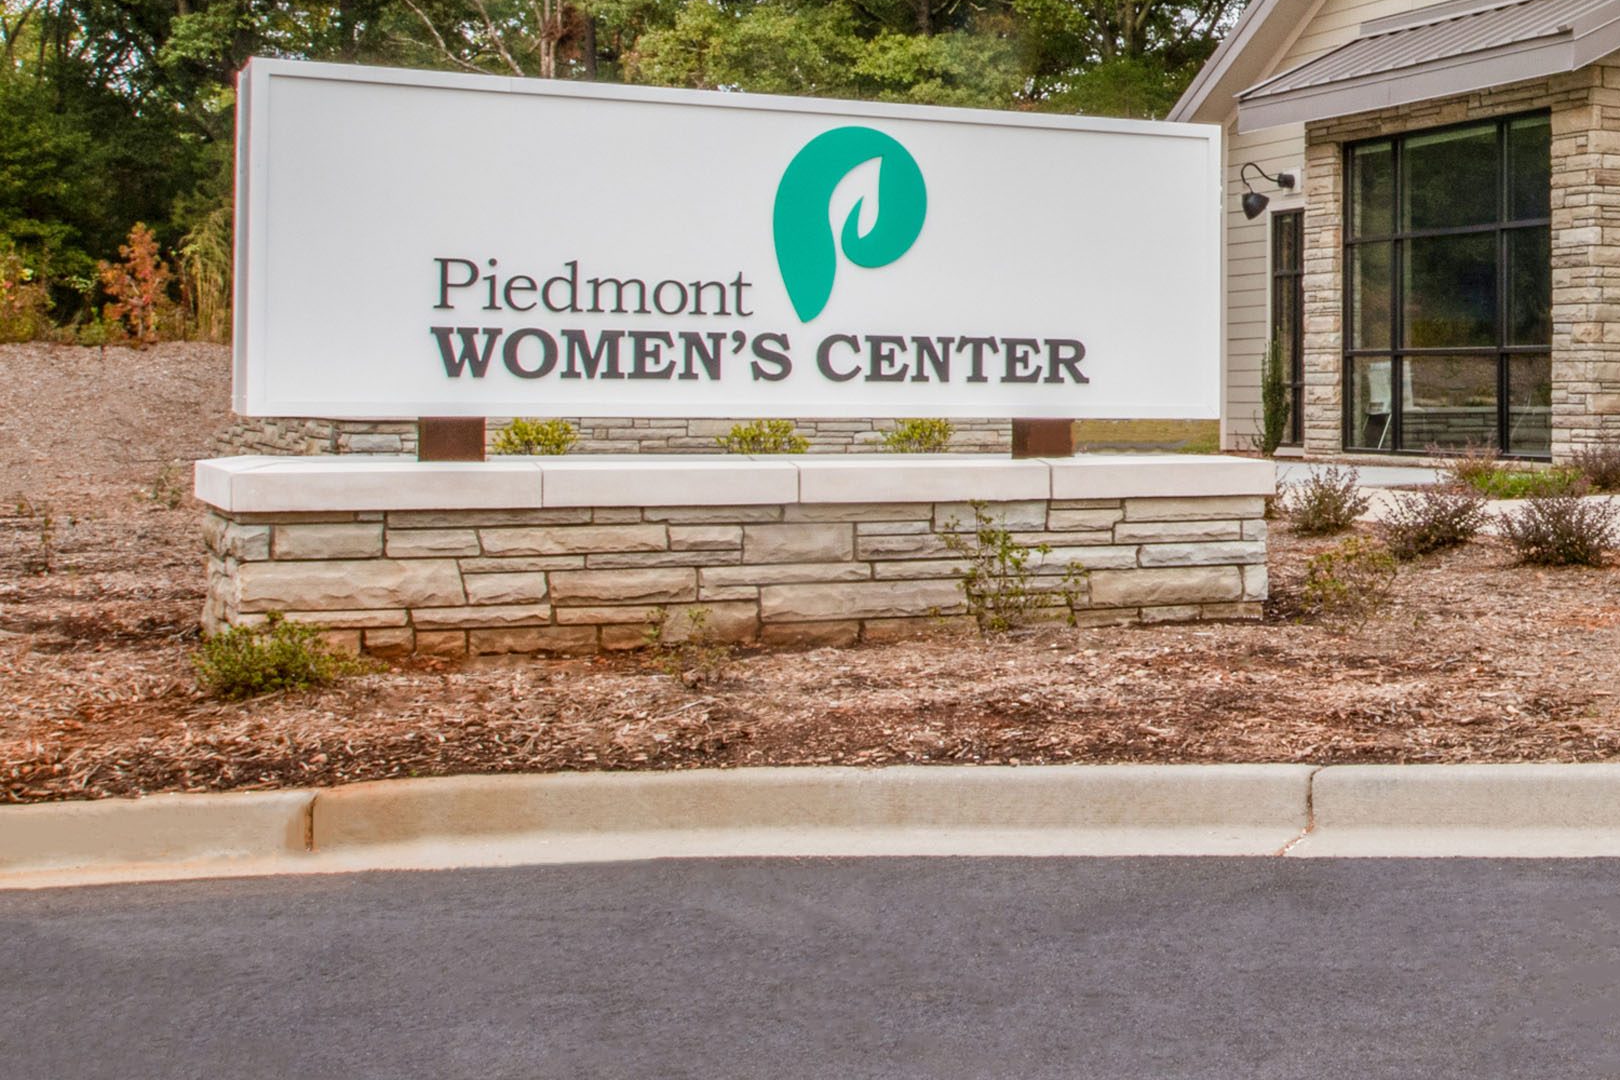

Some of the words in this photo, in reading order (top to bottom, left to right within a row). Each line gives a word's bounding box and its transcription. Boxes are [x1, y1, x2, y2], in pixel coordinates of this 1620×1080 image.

[433, 257, 754, 317] Piedmont
[430, 326, 792, 382] WOMEN'S
[816, 334, 1090, 384] CENTER
